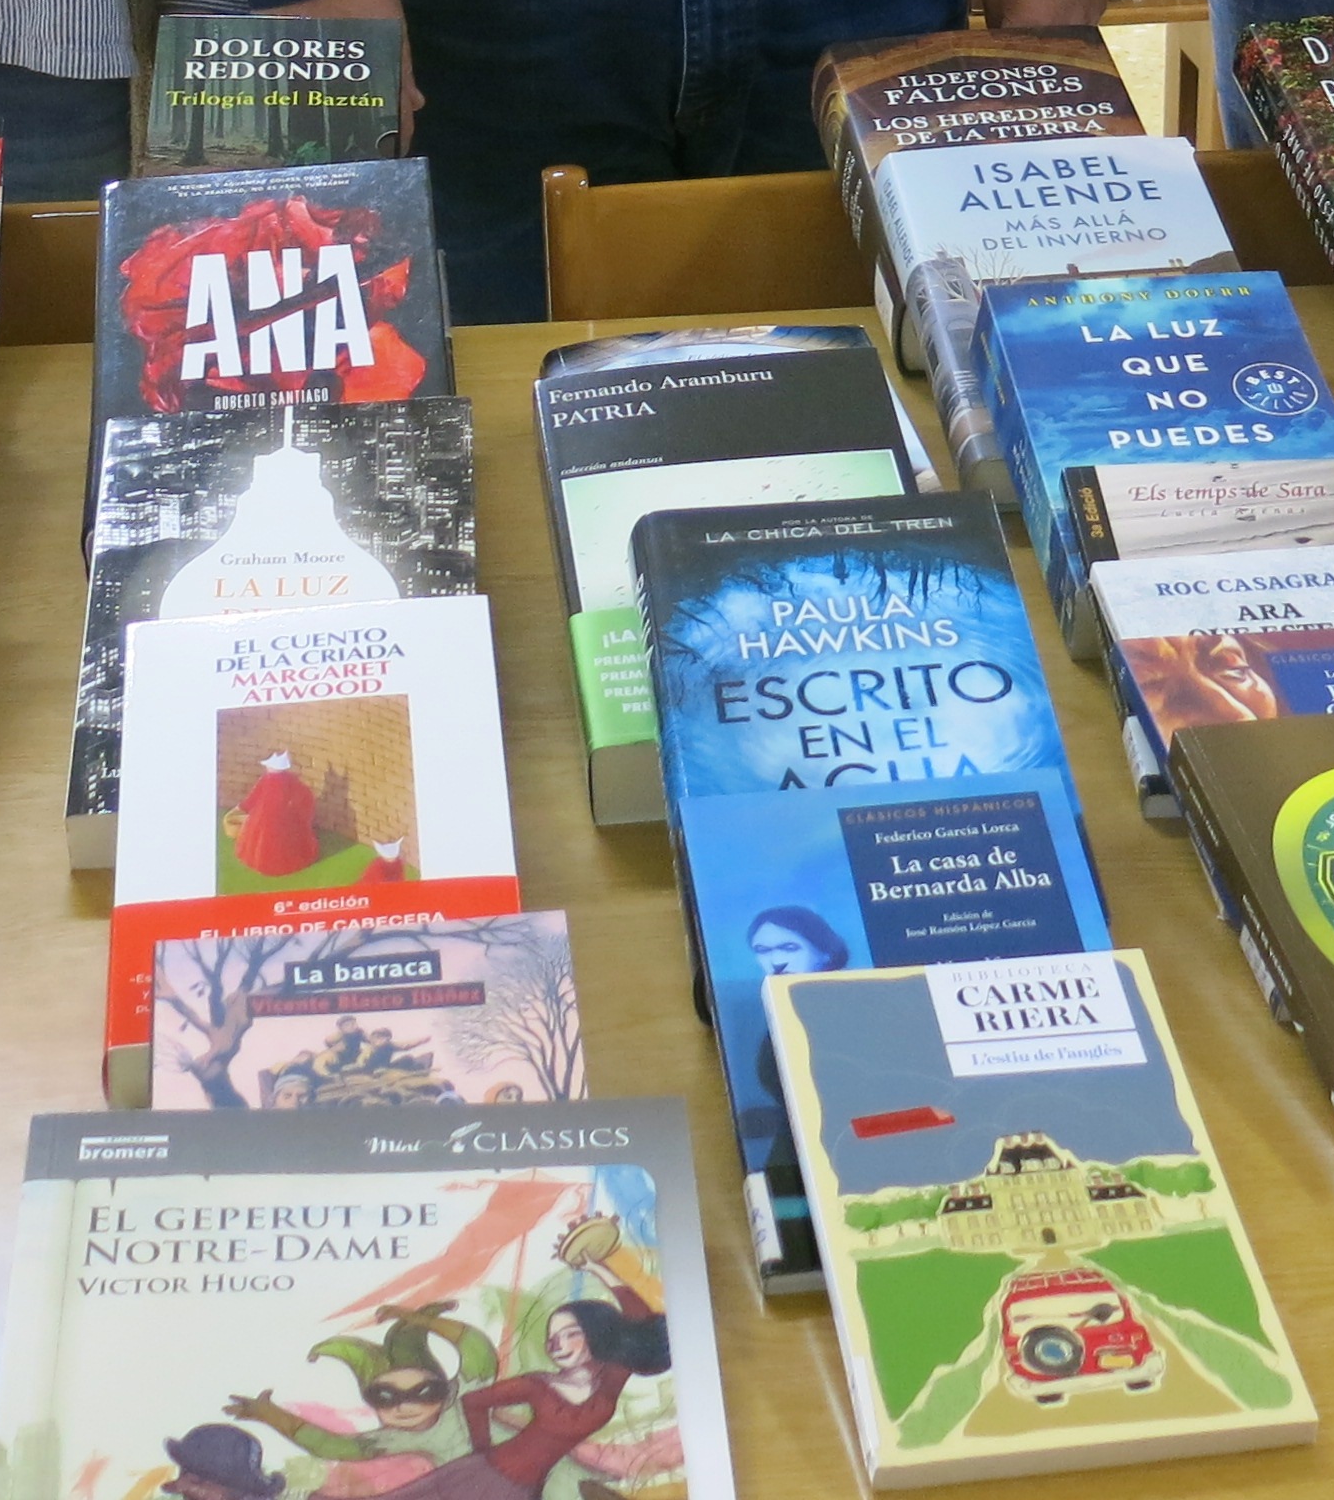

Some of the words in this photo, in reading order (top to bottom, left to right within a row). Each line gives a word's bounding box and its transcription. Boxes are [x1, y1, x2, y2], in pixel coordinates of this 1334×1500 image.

[192, 39, 366, 59] DOLORES
[183, 62, 371, 82] REDONDO
[898, 64, 1058, 89] ILDEFONSO
[166, 90, 254, 108] Trilogía
[264, 91, 298, 106] del
[308, 91, 385, 108] Baztán
[883, 76, 1083, 107] FALCONES
[873, 117, 929, 132] LOS
[938, 102, 1114, 130] HEREDEROS
[896, 130, 939, 146] DE
[946, 127, 986, 142] LA
[992, 118, 1106, 139] TIERRA
[973, 155, 1129, 186] ISABEL
[959, 179, 1164, 213] ALLENDE
[1005, 210, 1062, 232] MÁS
[1072, 209, 1135, 227] ALLÁ
[982, 234, 1028, 251] DEL
[1037, 227, 1167, 249] INVIERNO
[1026, 291, 1152, 307] ANTHONY
[1165, 285, 1253, 300] DOERR
[180, 244, 375, 381] ANA
[1081, 325, 1132, 343] LA
[1147, 319, 1224, 339] LUZ
[1121, 353, 1210, 377] QUE
[1244, 368, 1299, 387] BEST
[214, 392, 266, 410] ROBERTO
[271, 387, 329, 406] SANTIAGO
[549, 379, 652, 405] Fernando
[660, 368, 774, 390] Aramburu
[1146, 389, 1208, 411] NO
[552, 402, 657, 429] PATRIA
[1108, 422, 1275, 450] PUEDES
[1127, 482, 1168, 503] Els
[1173, 485, 1238, 503] temps
[1240, 484, 1270, 500] de
[1275, 481, 1327, 499] Sara
[705, 531, 735, 544] LA
[747, 525, 823, 541] CHICA
[836, 520, 882, 536] DEL
[890, 516, 954, 531] TREN
[220, 553, 287, 566] Graham
[293, 551, 346, 564] Moore
[214, 579, 265, 598] LA
[275, 574, 349, 596] LUZ
[1154, 580, 1211, 597] ROC
[770, 593, 914, 627] PAULA
[1237, 602, 1304, 622] ARA
[233, 639, 261, 655] EL
[271, 627, 387, 651] CUENTO
[737, 619, 959, 661] HAWKINS
[216, 656, 255, 674] DE
[259, 653, 295, 669] LA
[301, 642, 405, 665] CRIADA
[231, 661, 391, 689] MARGARET
[242, 678, 382, 704] ATWOOD
[715, 660, 1013, 725] ESCRITO
[800, 721, 875, 759] EN
[894, 717, 948, 751] EL
[874, 829, 932, 846] Federico
[935, 825, 980, 841] García
[982, 822, 1020, 835] Lorca
[891, 854, 923, 875] La
[928, 853, 982, 872] casa
[988, 846, 1018, 866] de
[870, 874, 989, 902] Bernarda
[994, 869, 1052, 889] Alba
[298, 895, 370, 912] edición
[299, 921, 327, 934] DE
[332, 912, 446, 931] CABECERA
[293, 966, 323, 985] La
[335, 959, 433, 982] barraca
[951, 961, 1095, 984] BIBLIOTECA
[955, 977, 1101, 1008] CARME
[973, 1004, 1101, 1034] RIERA
[87, 1205, 138, 1234] EL
[153, 1203, 362, 1232] GEPERUT
[381, 1202, 440, 1228] DE
[83, 1234, 412, 1268] NOTRE-DAME
[76, 1274, 190, 1297] VICTOR
[201, 1271, 296, 1294] HUGO
